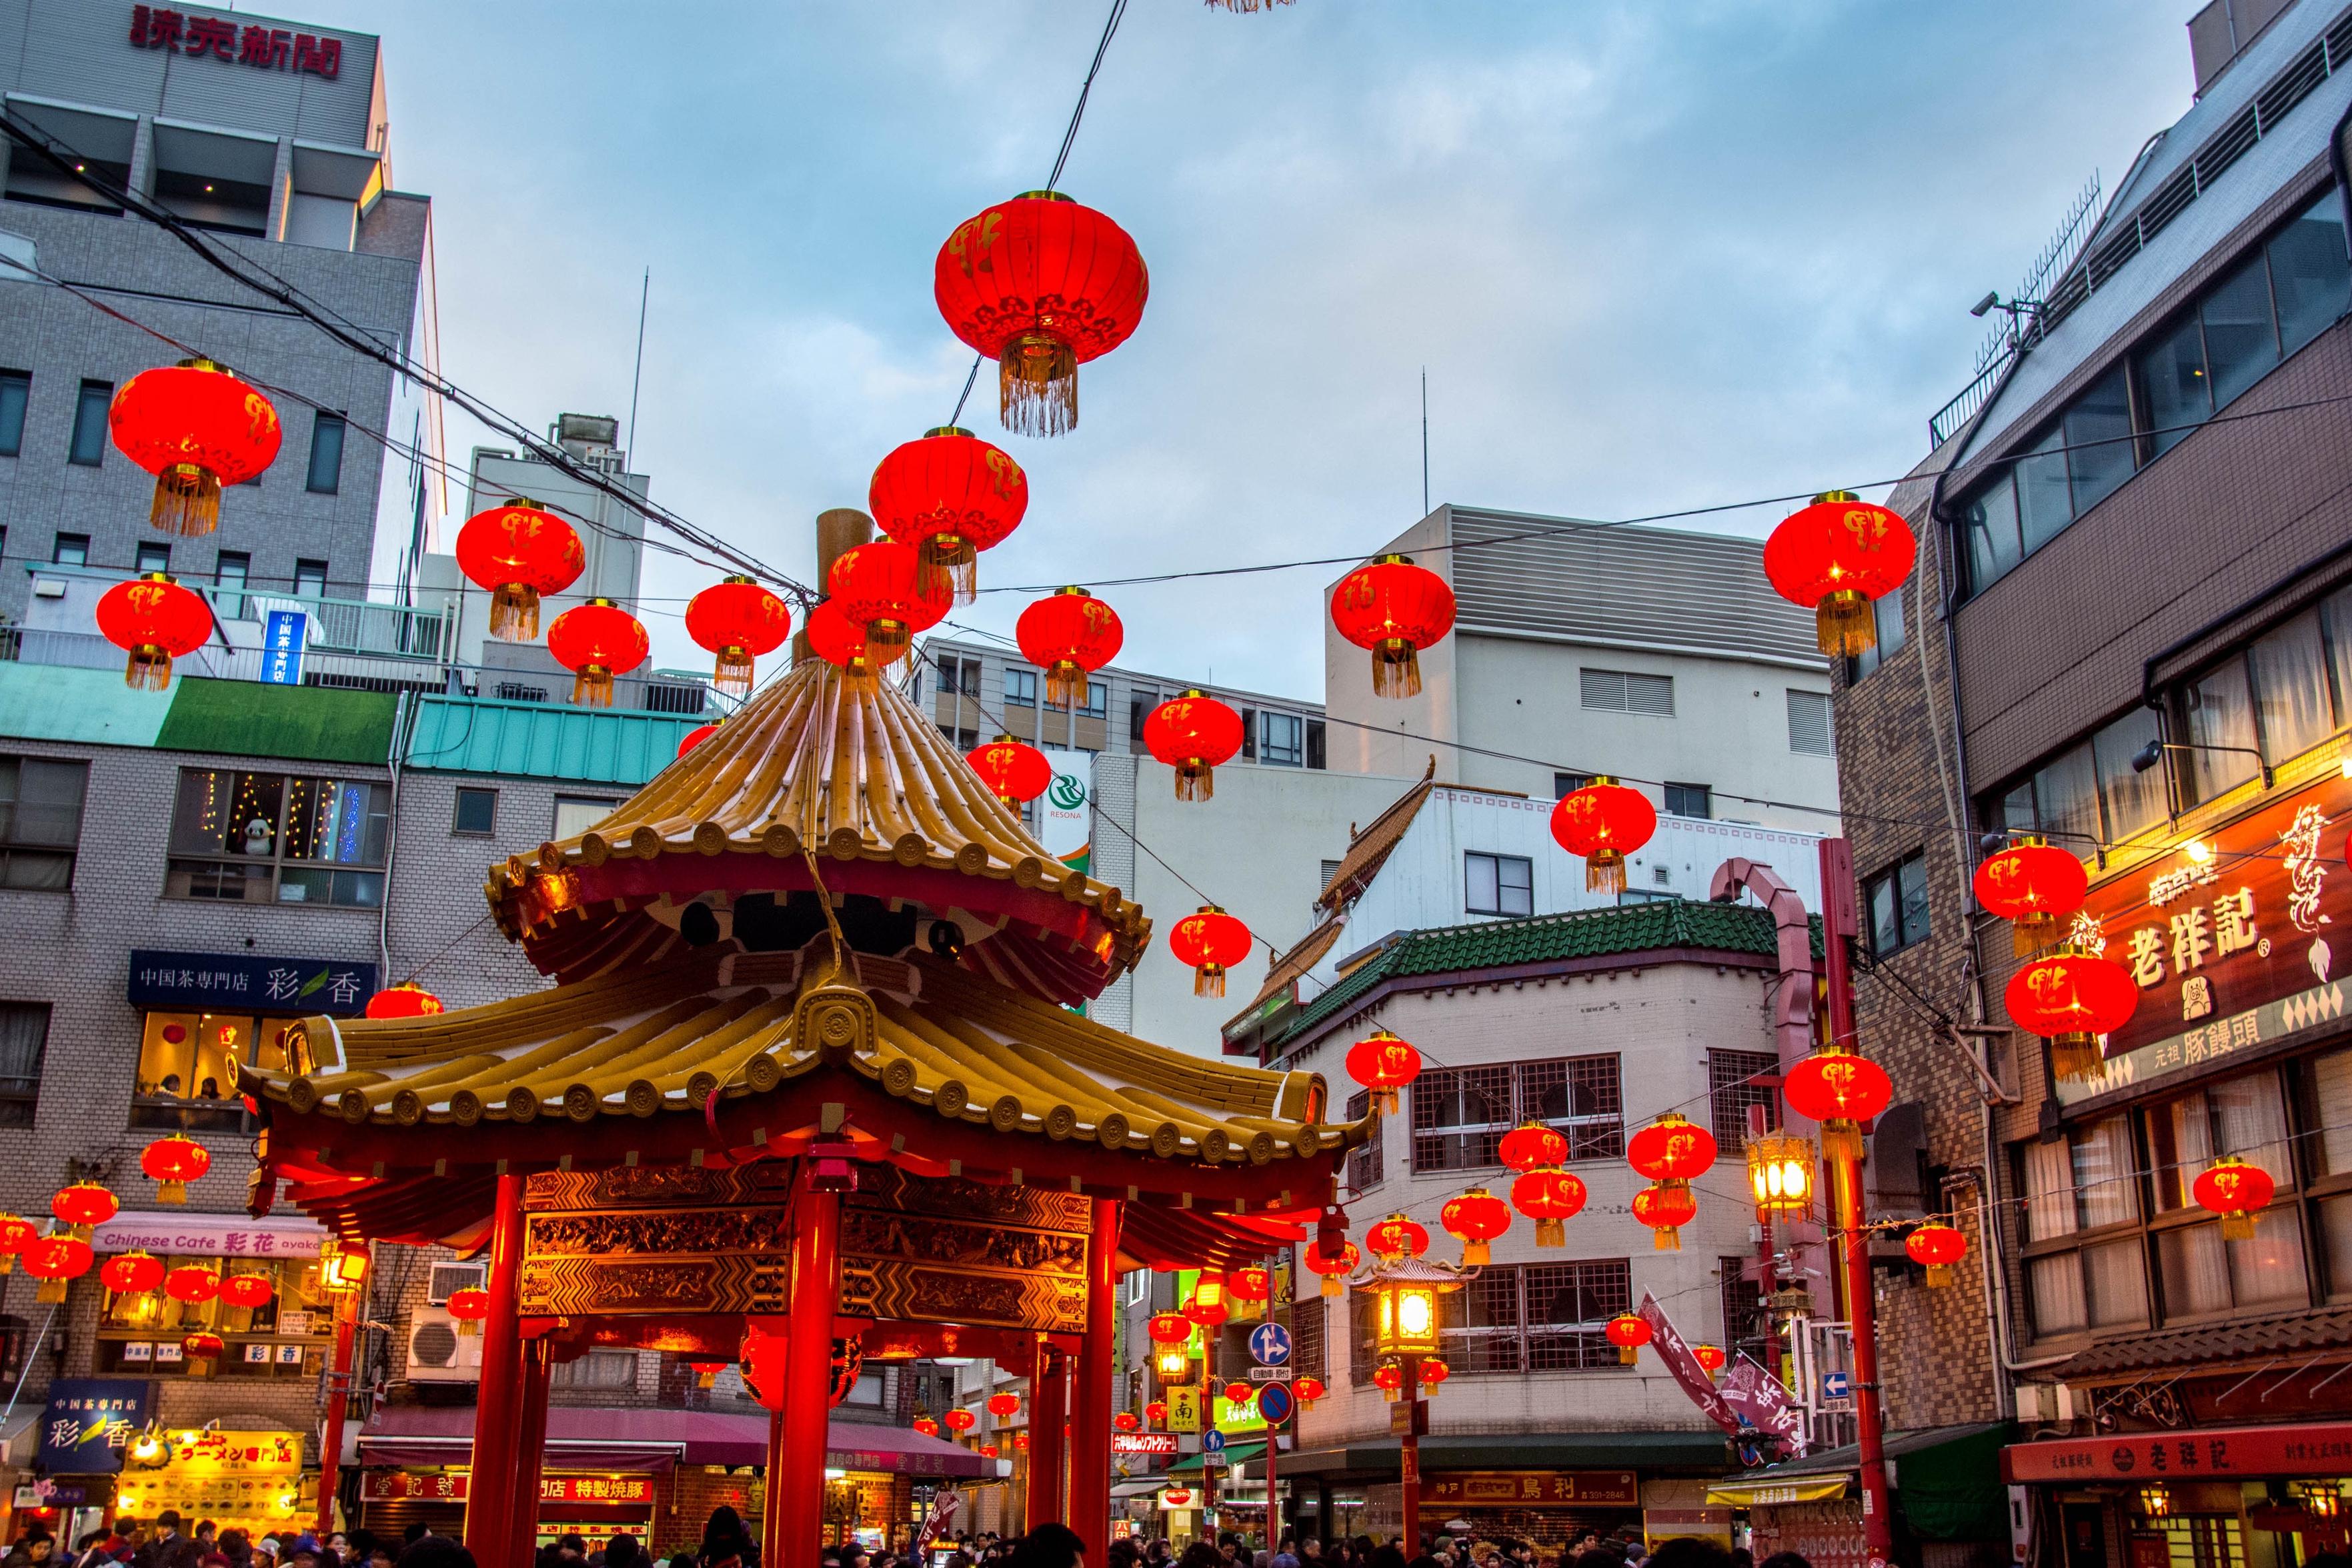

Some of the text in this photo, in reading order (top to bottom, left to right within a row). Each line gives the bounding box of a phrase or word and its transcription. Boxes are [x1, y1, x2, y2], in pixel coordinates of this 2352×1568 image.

[130, 5, 343, 77] 読売新聞
[1050, 811, 1081, 819] RESONA
[2126, 885, 2259, 987] 老祥記
[140, 967, 249, 991] 中国茶専門店
[2155, 1008, 2261, 1068] 元祖 豚饅頭
[104, 1233, 170, 1247] Chinese
[175, 1235, 216, 1249] Cafe
[224, 1232, 275, 1253] 彩花
[1175, 1401, 1193, 1420] 南
[180, 1447, 293, 1463] ラーメン専門店
[2150, 1440, 2230, 1472] 老祥記
